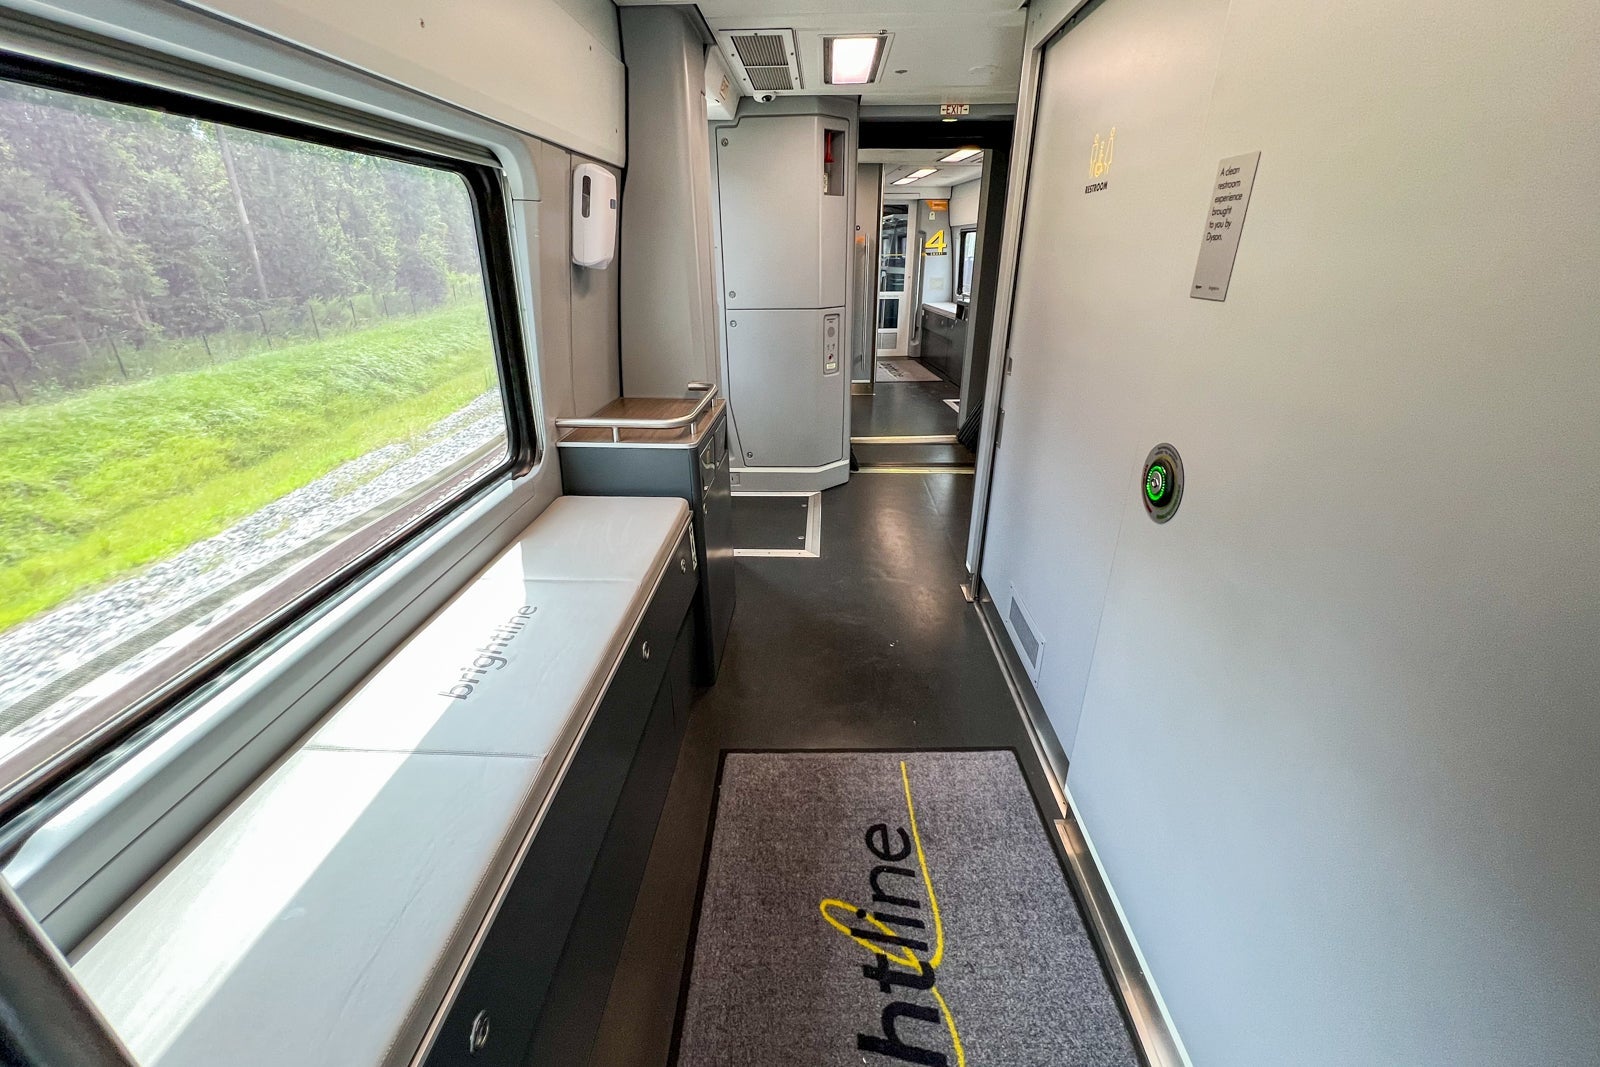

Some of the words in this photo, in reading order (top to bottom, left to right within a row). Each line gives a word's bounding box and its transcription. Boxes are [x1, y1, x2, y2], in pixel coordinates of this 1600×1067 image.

[946, 104, 964, 116] EXIT
[1225, 166, 1241, 177] clean
[1085, 181, 1108, 194] RESTROOM
[1217, 180, 1241, 190] restroom
[1214, 192, 1243, 203] experience
[1211, 206, 1232, 217] brought
[1209, 221, 1214, 229] to
[1215, 221, 1225, 230] you
[1225, 218, 1232, 229] by
[925, 230, 947, 253] 4
[438, 604, 538, 700] brightline
